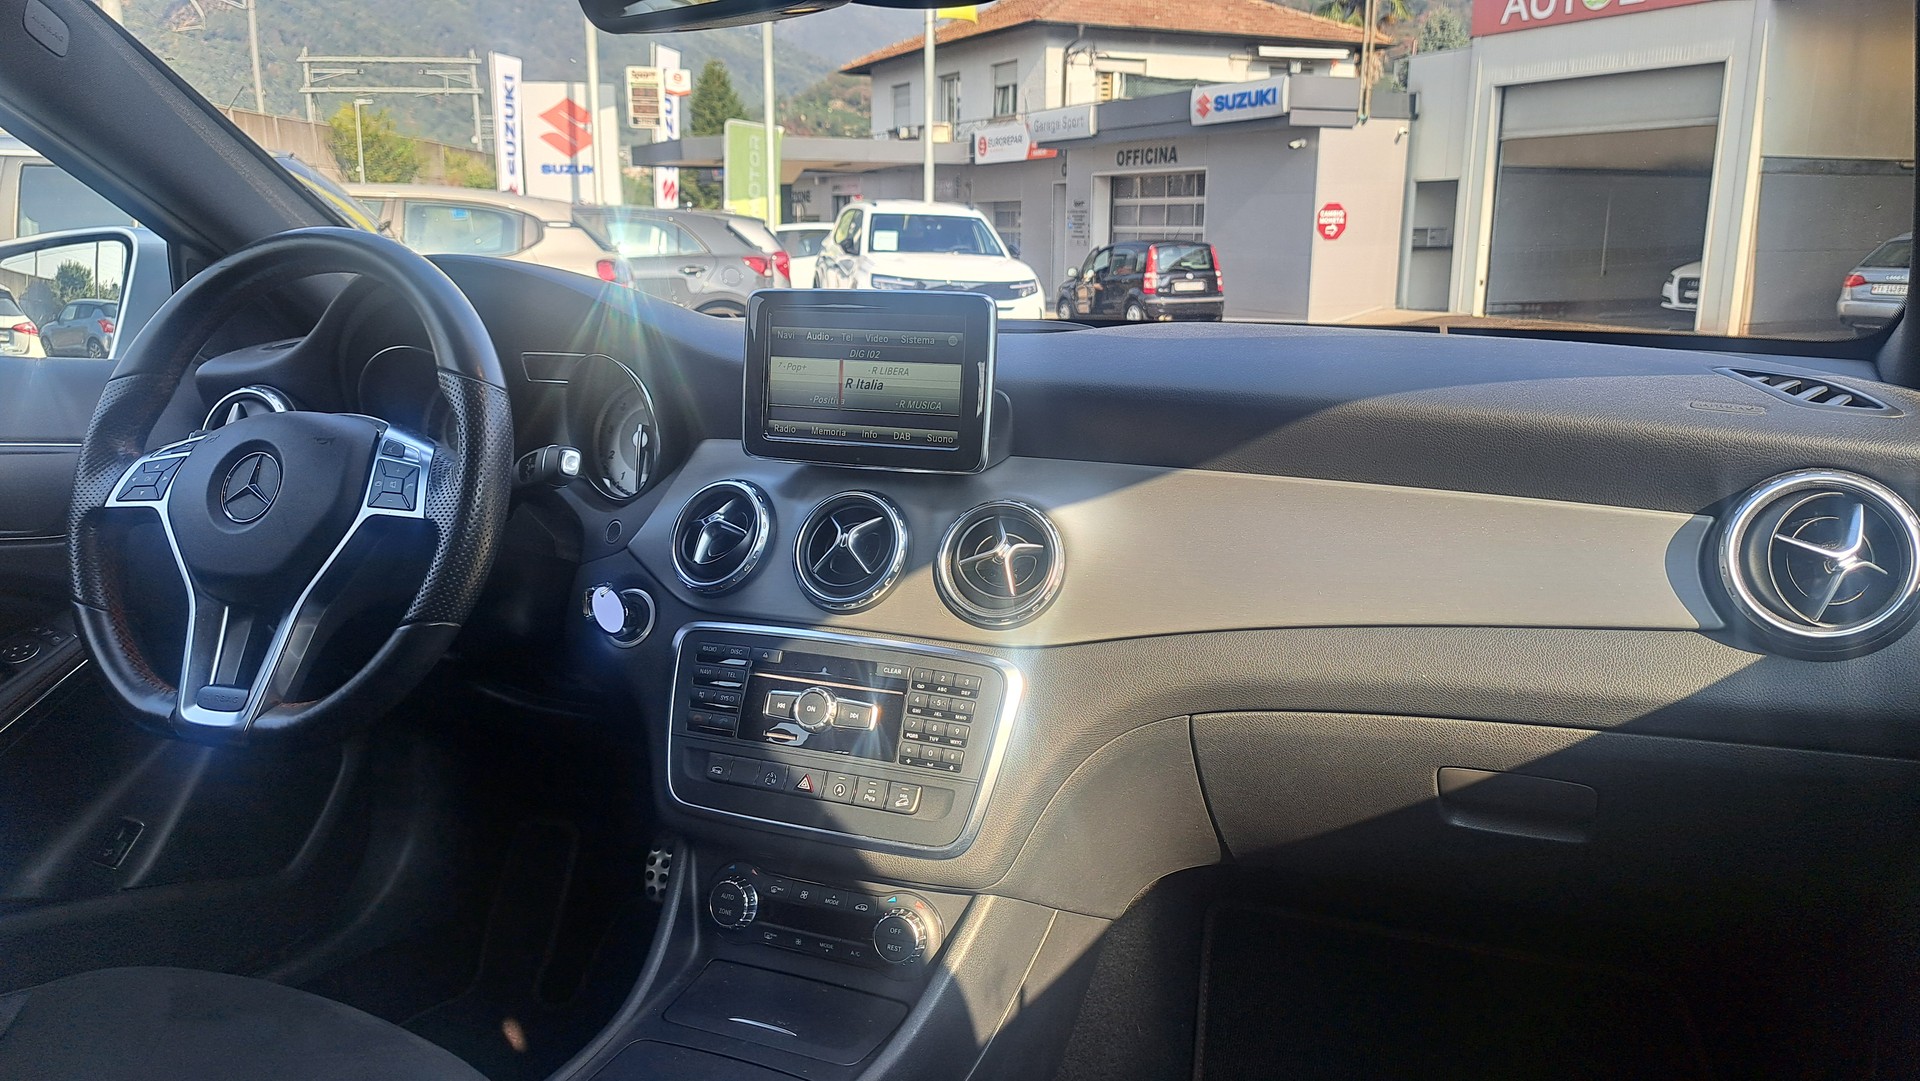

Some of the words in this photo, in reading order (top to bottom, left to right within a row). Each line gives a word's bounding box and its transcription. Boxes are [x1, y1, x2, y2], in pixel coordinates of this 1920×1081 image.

[1213, 87, 1278, 112] SUZUKI
[504, 75, 516, 176] SUZUKI
[1116, 146, 1178, 166] OFFICINA
[541, 164, 593, 175] SUZUK
[777, 330, 795, 340] Navi
[806, 331, 830, 341] Audio
[841, 332, 853, 342] Tel
[865, 334, 889, 343] Video
[900, 335, 935, 345] Sistema
[849, 349, 865, 358] DIG
[879, 367, 910, 376] LIBERA
[845, 378, 854, 389] R
[856, 378, 884, 390] Italia
[907, 401, 942, 410] MUSICA
[774, 424, 796, 433] Radio
[811, 426, 847, 437] Memoria
[861, 429, 878, 439] Info
[893, 431, 911, 441] DAB
[926, 433, 954, 444] Suono
[608, 450, 616, 460] 2
[702, 645, 718, 653] RADIO
[883, 667, 902, 675] CLEAR
[806, 705, 816, 713] ON
[720, 892, 735, 901] AUTO
[824, 898, 840, 906] MODE
[718, 907, 732, 916] ZONE
[889, 927, 902, 935] OFF
[819, 942, 834, 950] MODE
[886, 943, 902, 953] REST
